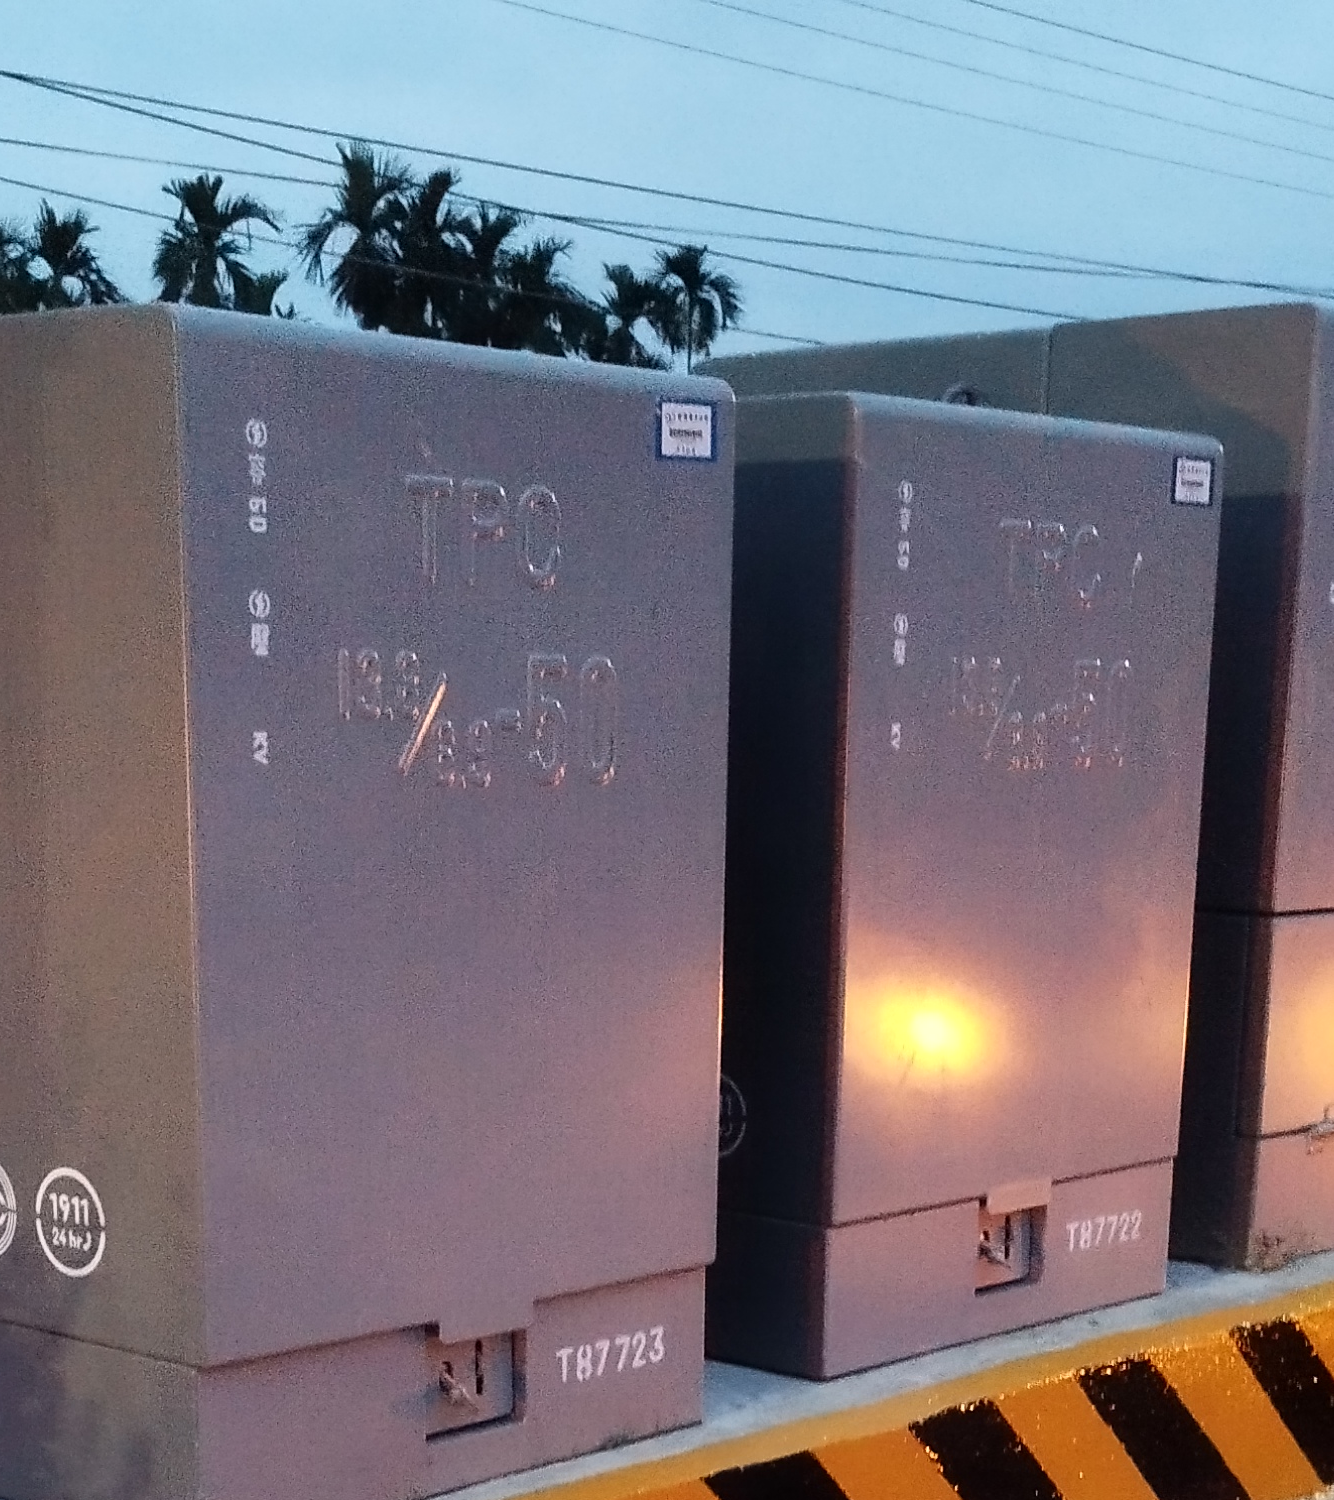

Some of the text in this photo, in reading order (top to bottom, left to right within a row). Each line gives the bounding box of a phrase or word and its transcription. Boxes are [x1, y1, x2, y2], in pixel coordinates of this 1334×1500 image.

[49, 1192, 89, 1227] 1911
[1066, 1208, 1142, 1253] T87722
[556, 1325, 666, 1383] T87723
